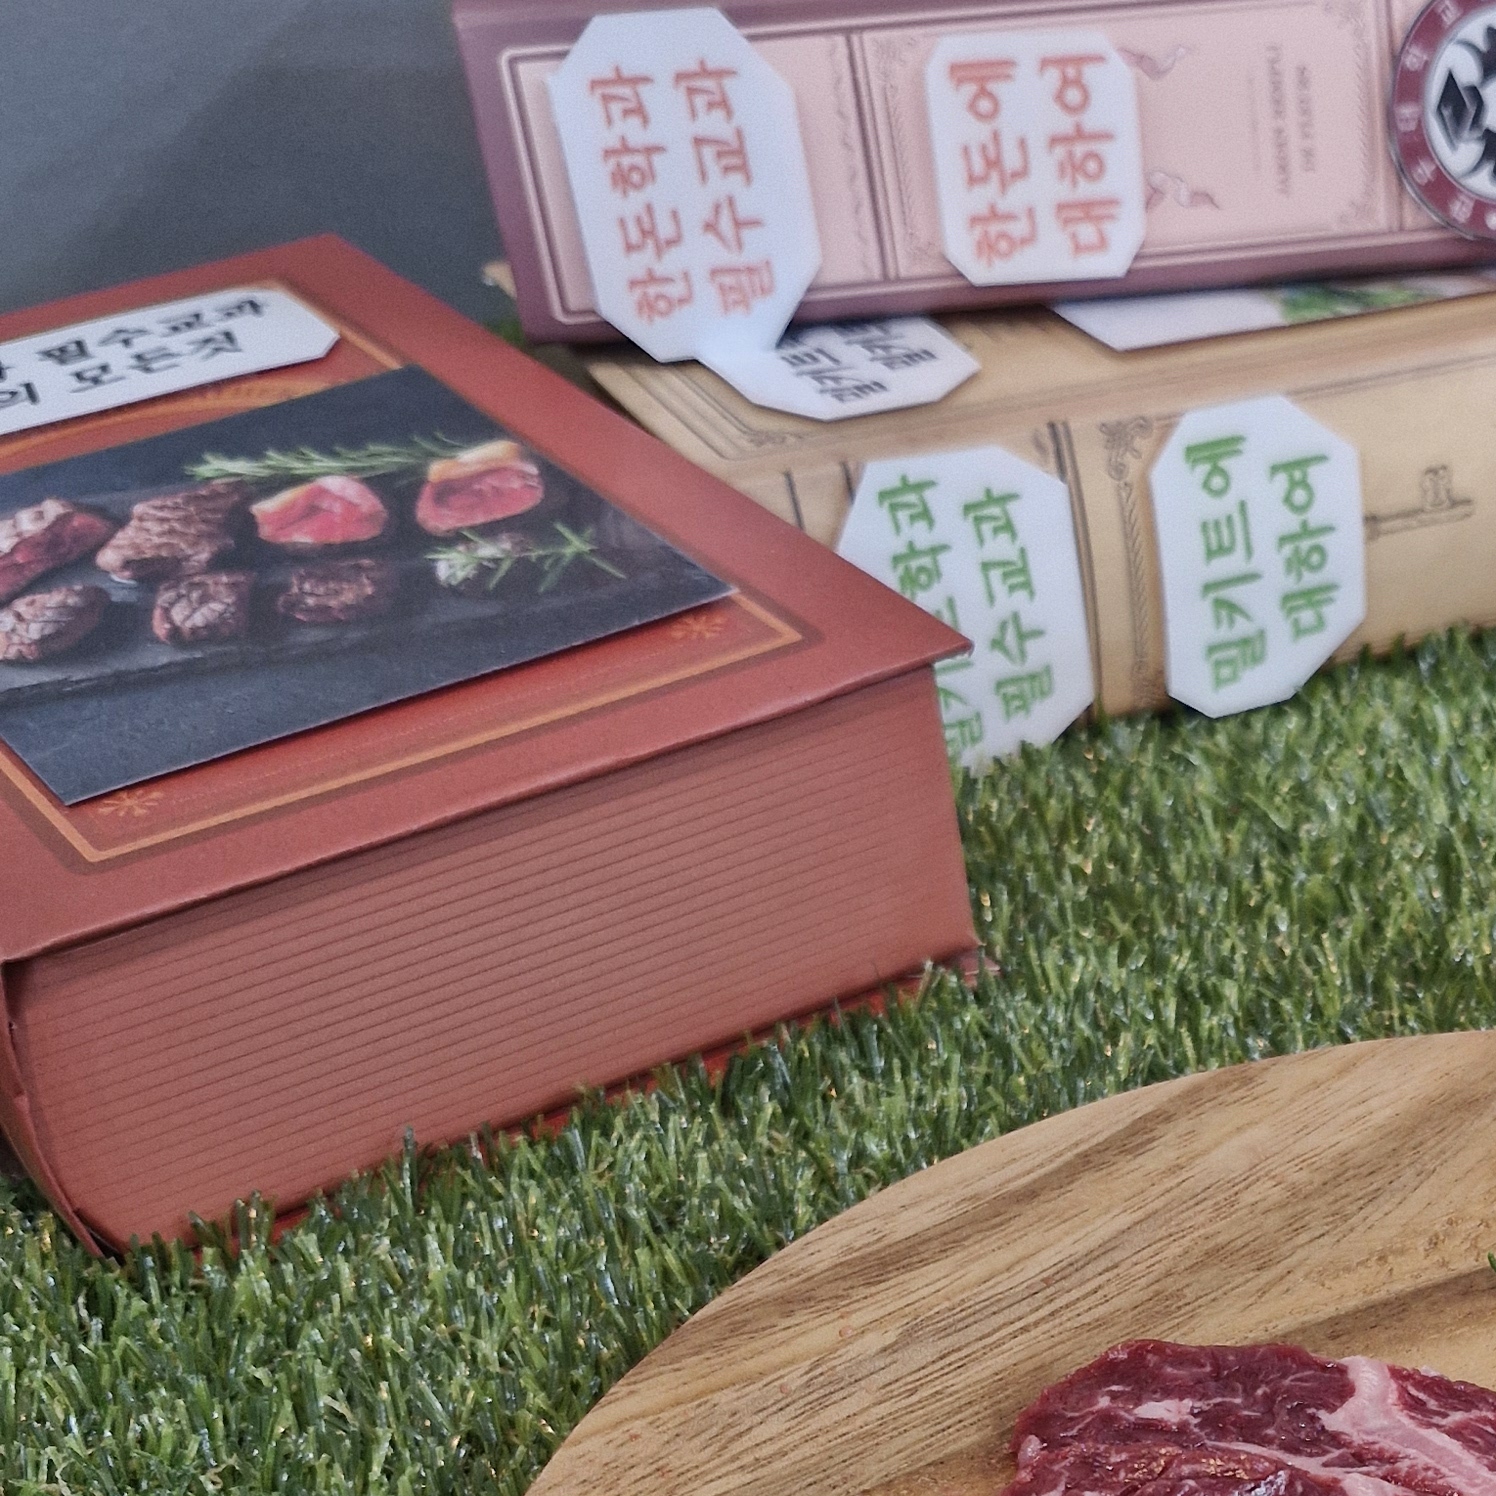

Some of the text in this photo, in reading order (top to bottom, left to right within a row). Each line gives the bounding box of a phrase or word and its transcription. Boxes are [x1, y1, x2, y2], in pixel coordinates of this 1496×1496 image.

[589, 63, 694, 322] 한돈학과
[674, 60, 776, 317] 필수교과
[949, 58, 1038, 267] 한돈에
[1040, 54, 1120, 258] 대하여
[963, 486, 1053, 722] 필수교과
[1184, 434, 1267, 692] 밀키트에
[1270, 455, 1339, 641] 대하여
